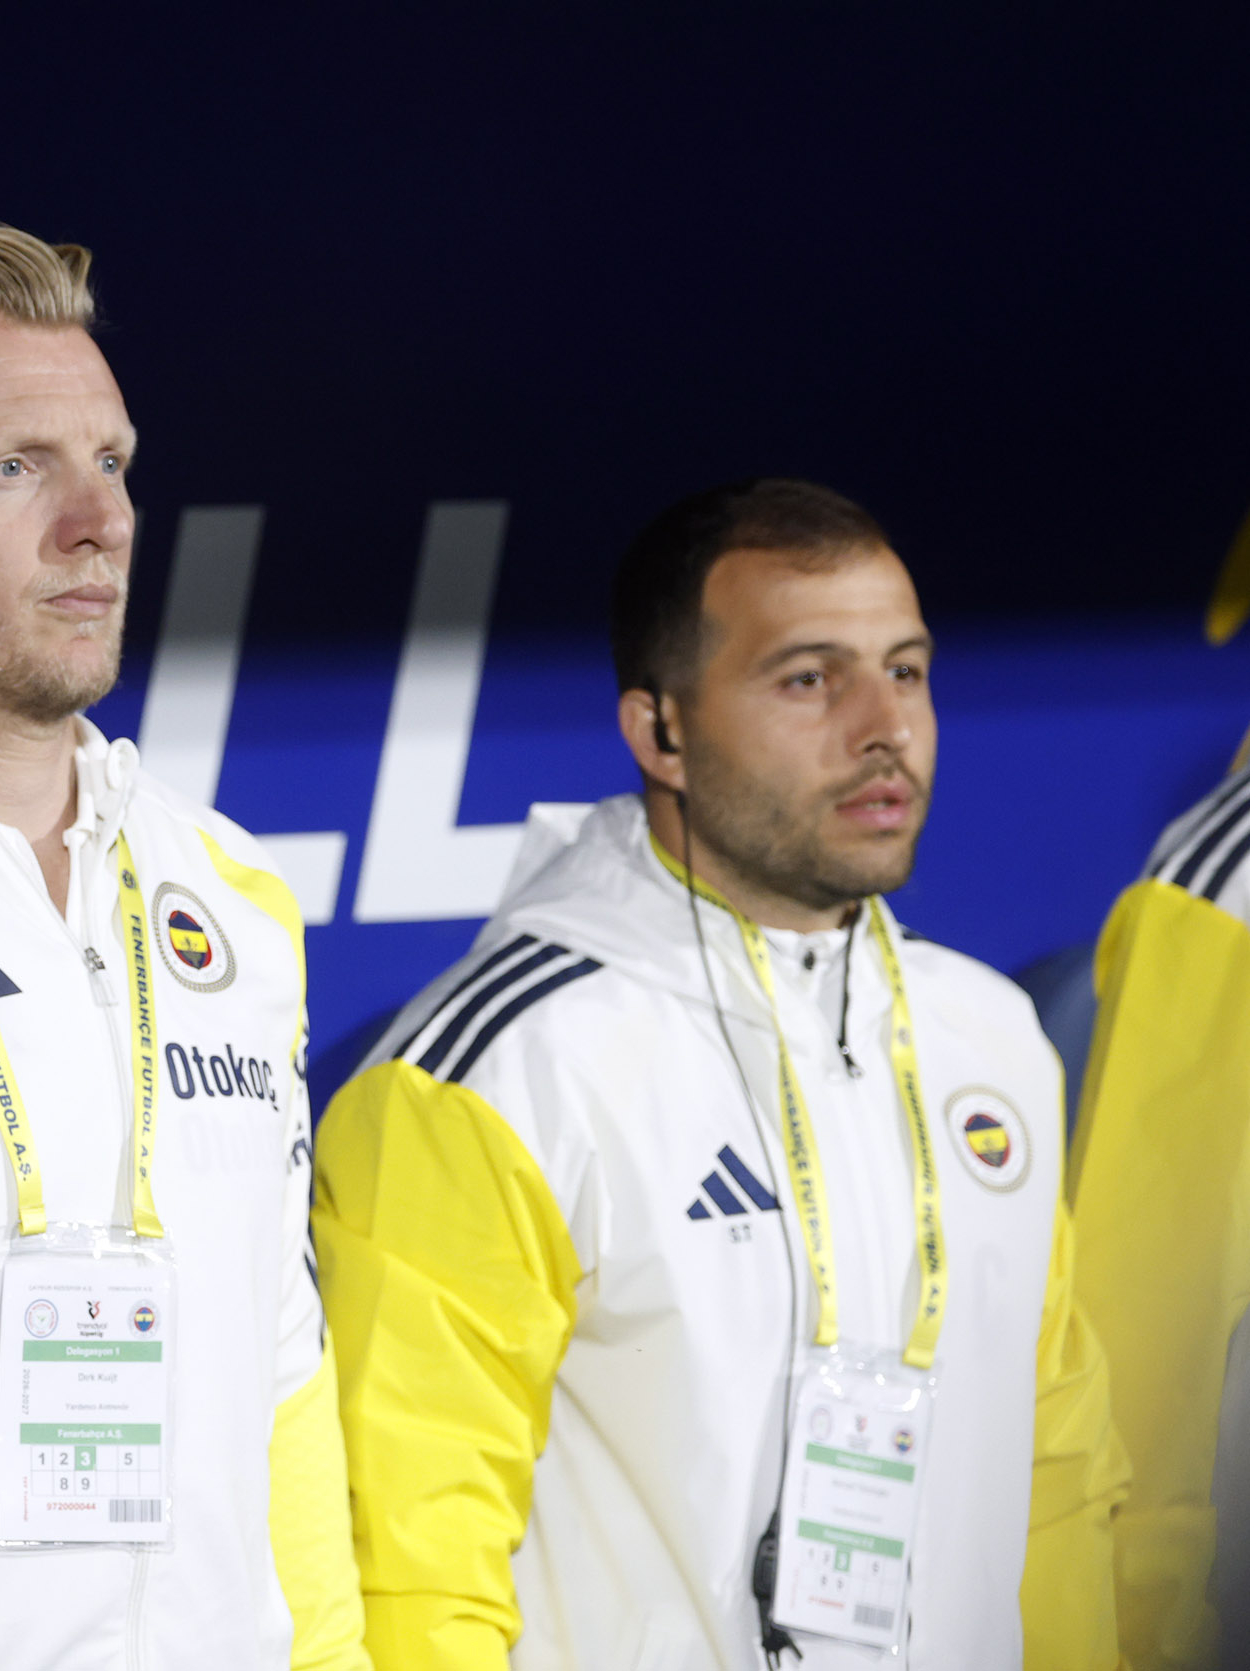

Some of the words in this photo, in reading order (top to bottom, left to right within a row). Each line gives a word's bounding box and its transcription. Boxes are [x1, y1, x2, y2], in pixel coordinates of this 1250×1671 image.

[130, 914, 152, 1051] FENERBAHÇE
[141, 1056, 153, 1136] FUTBOL
[165, 1042, 280, 1112] Otokoç
[13, 1142, 32, 1182] A.Ş.
[78, 1373, 95, 1382] Dirk
[97, 1373, 118, 1384] Kuijt
[57, 1428, 105, 1440] Fenerbahçe
[38, 1452, 46, 1466] 1
[59, 1452, 69, 1465] 2
[80, 1451, 91, 1467] 3
[124, 1452, 133, 1466] 5
[60, 1477, 69, 1491] 8
[81, 1477, 90, 1491] 9
